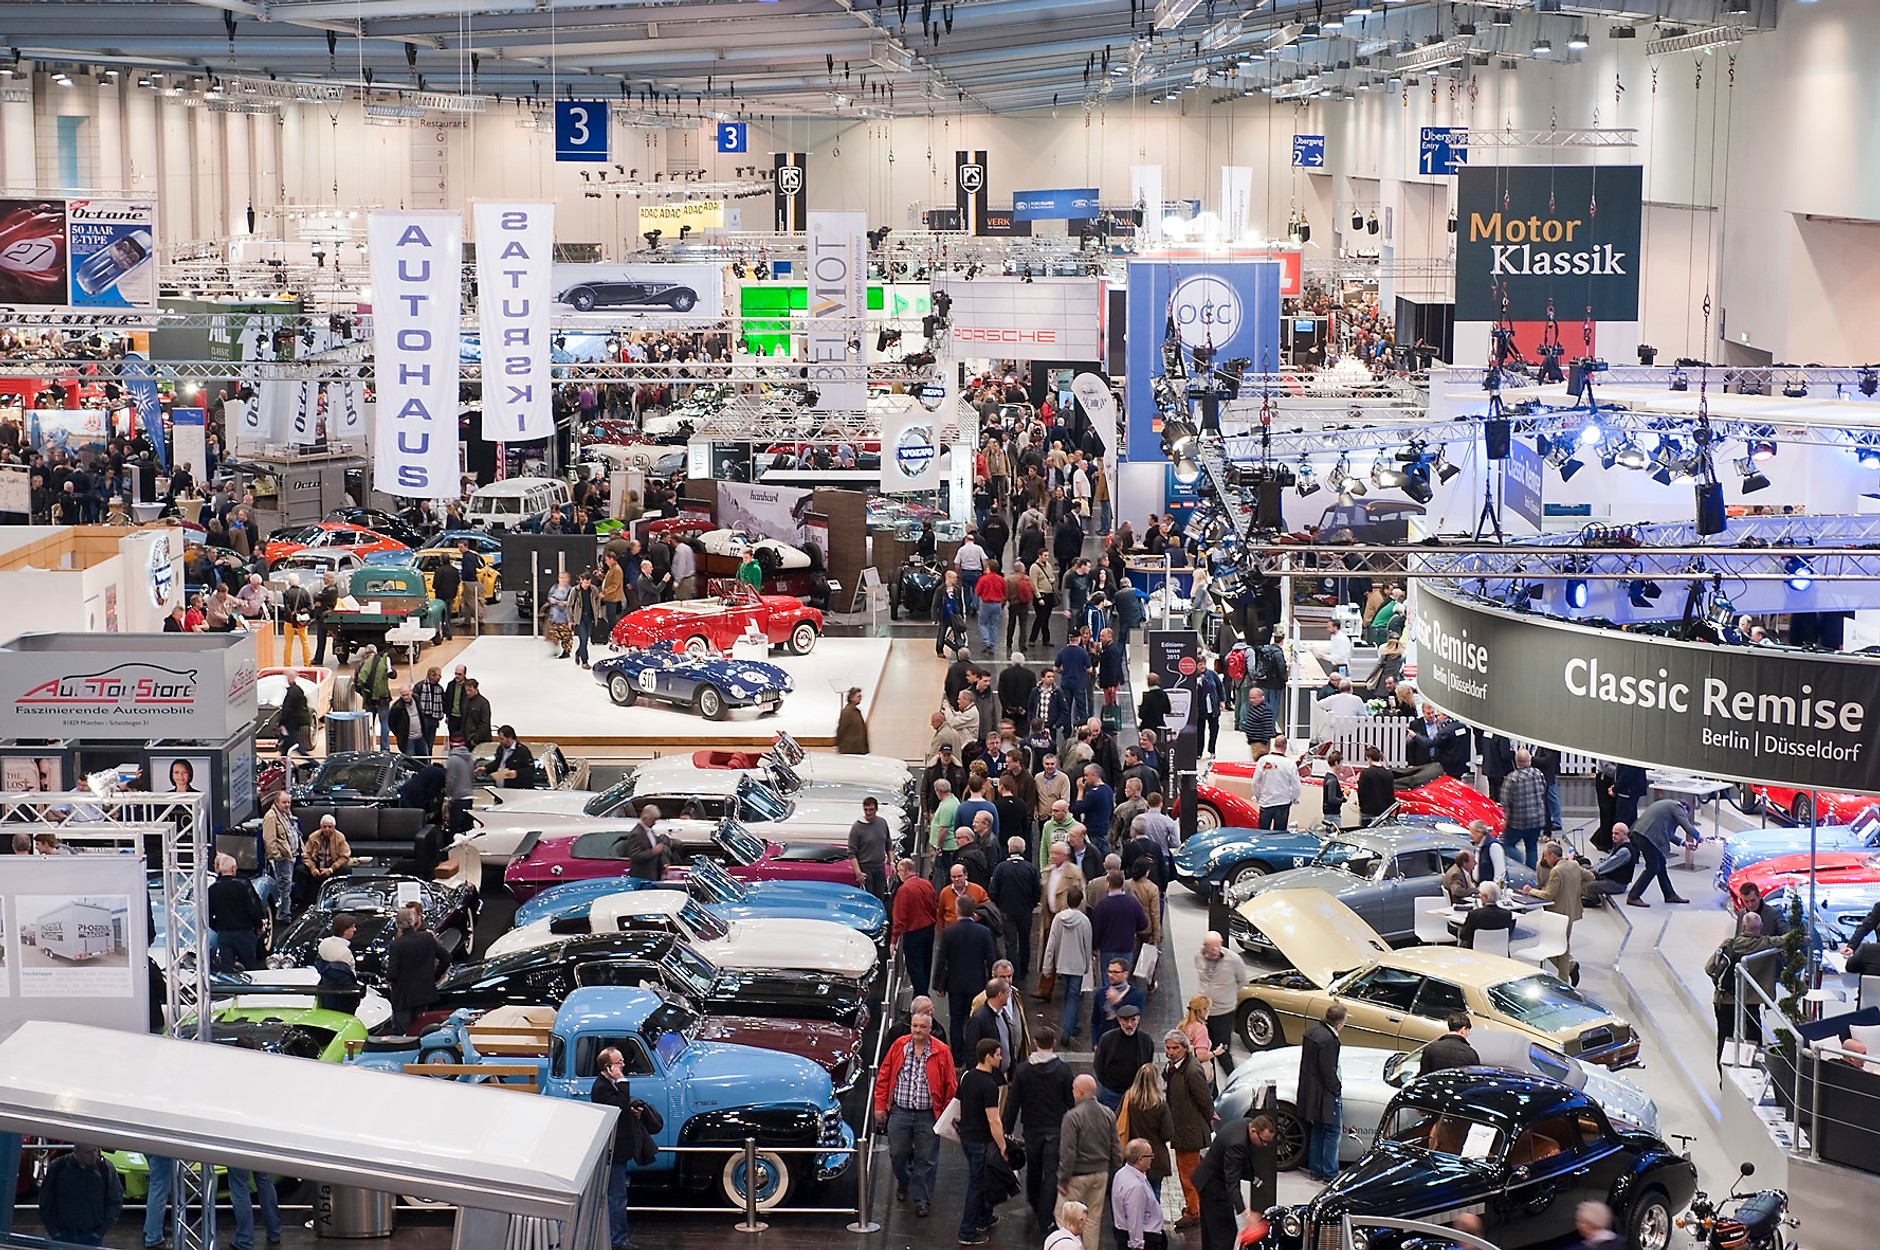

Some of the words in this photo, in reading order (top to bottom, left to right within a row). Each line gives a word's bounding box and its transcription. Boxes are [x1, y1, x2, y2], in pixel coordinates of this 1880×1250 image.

[420, 119, 467, 128] Restaurant
[569, 107, 590, 145] 3
[725, 127, 738, 149] 3
[1294, 136, 1324, 147] Übergang
[1422, 128, 1468, 145] Übergang
[1422, 141, 1439, 151] Entry
[1293, 151, 1303, 166] 2
[1422, 152, 1432, 173] 1
[640, 209, 658, 219] ADAC
[659, 209, 681, 219] ADAC
[683, 205, 703, 215] ADAC
[703, 202, 723, 211] ADAC
[72, 208, 147, 221] Octane
[71, 225, 85, 235] 50
[86, 226, 114, 236] JAAR
[1469, 212, 1582, 242] Motor
[71, 235, 108, 245] E-TYPE
[3, 243, 53, 265] 27
[1490, 244, 1627, 275] Klassik
[954, 328, 1056, 343] PORSCHE
[396, 225, 432, 488] AUTOHAUS
[901, 448, 934, 458] VOLVO
[750, 489, 779, 503] hanhart
[1433, 620, 1488, 673] Remise
[641, 671, 654, 688] 311
[1433, 664, 1447, 685] Berlin
[1450, 673, 1488, 699] Düsseldorf
[22, 678, 197, 699] AutoToyStore
[1564, 657, 1690, 713] Classic
[1703, 678, 1864, 733] Remise
[16, 705, 109, 715] Faszinierende
[113, 705, 194, 715] Automobile
[1702, 727, 1749, 750] Berlin
[1764, 735, 1862, 761] Düsseldorf
[6, 772, 22, 780] THE
[78, 924, 111, 932] PHOENIX
[320, 1185, 332, 1226] Abfa
